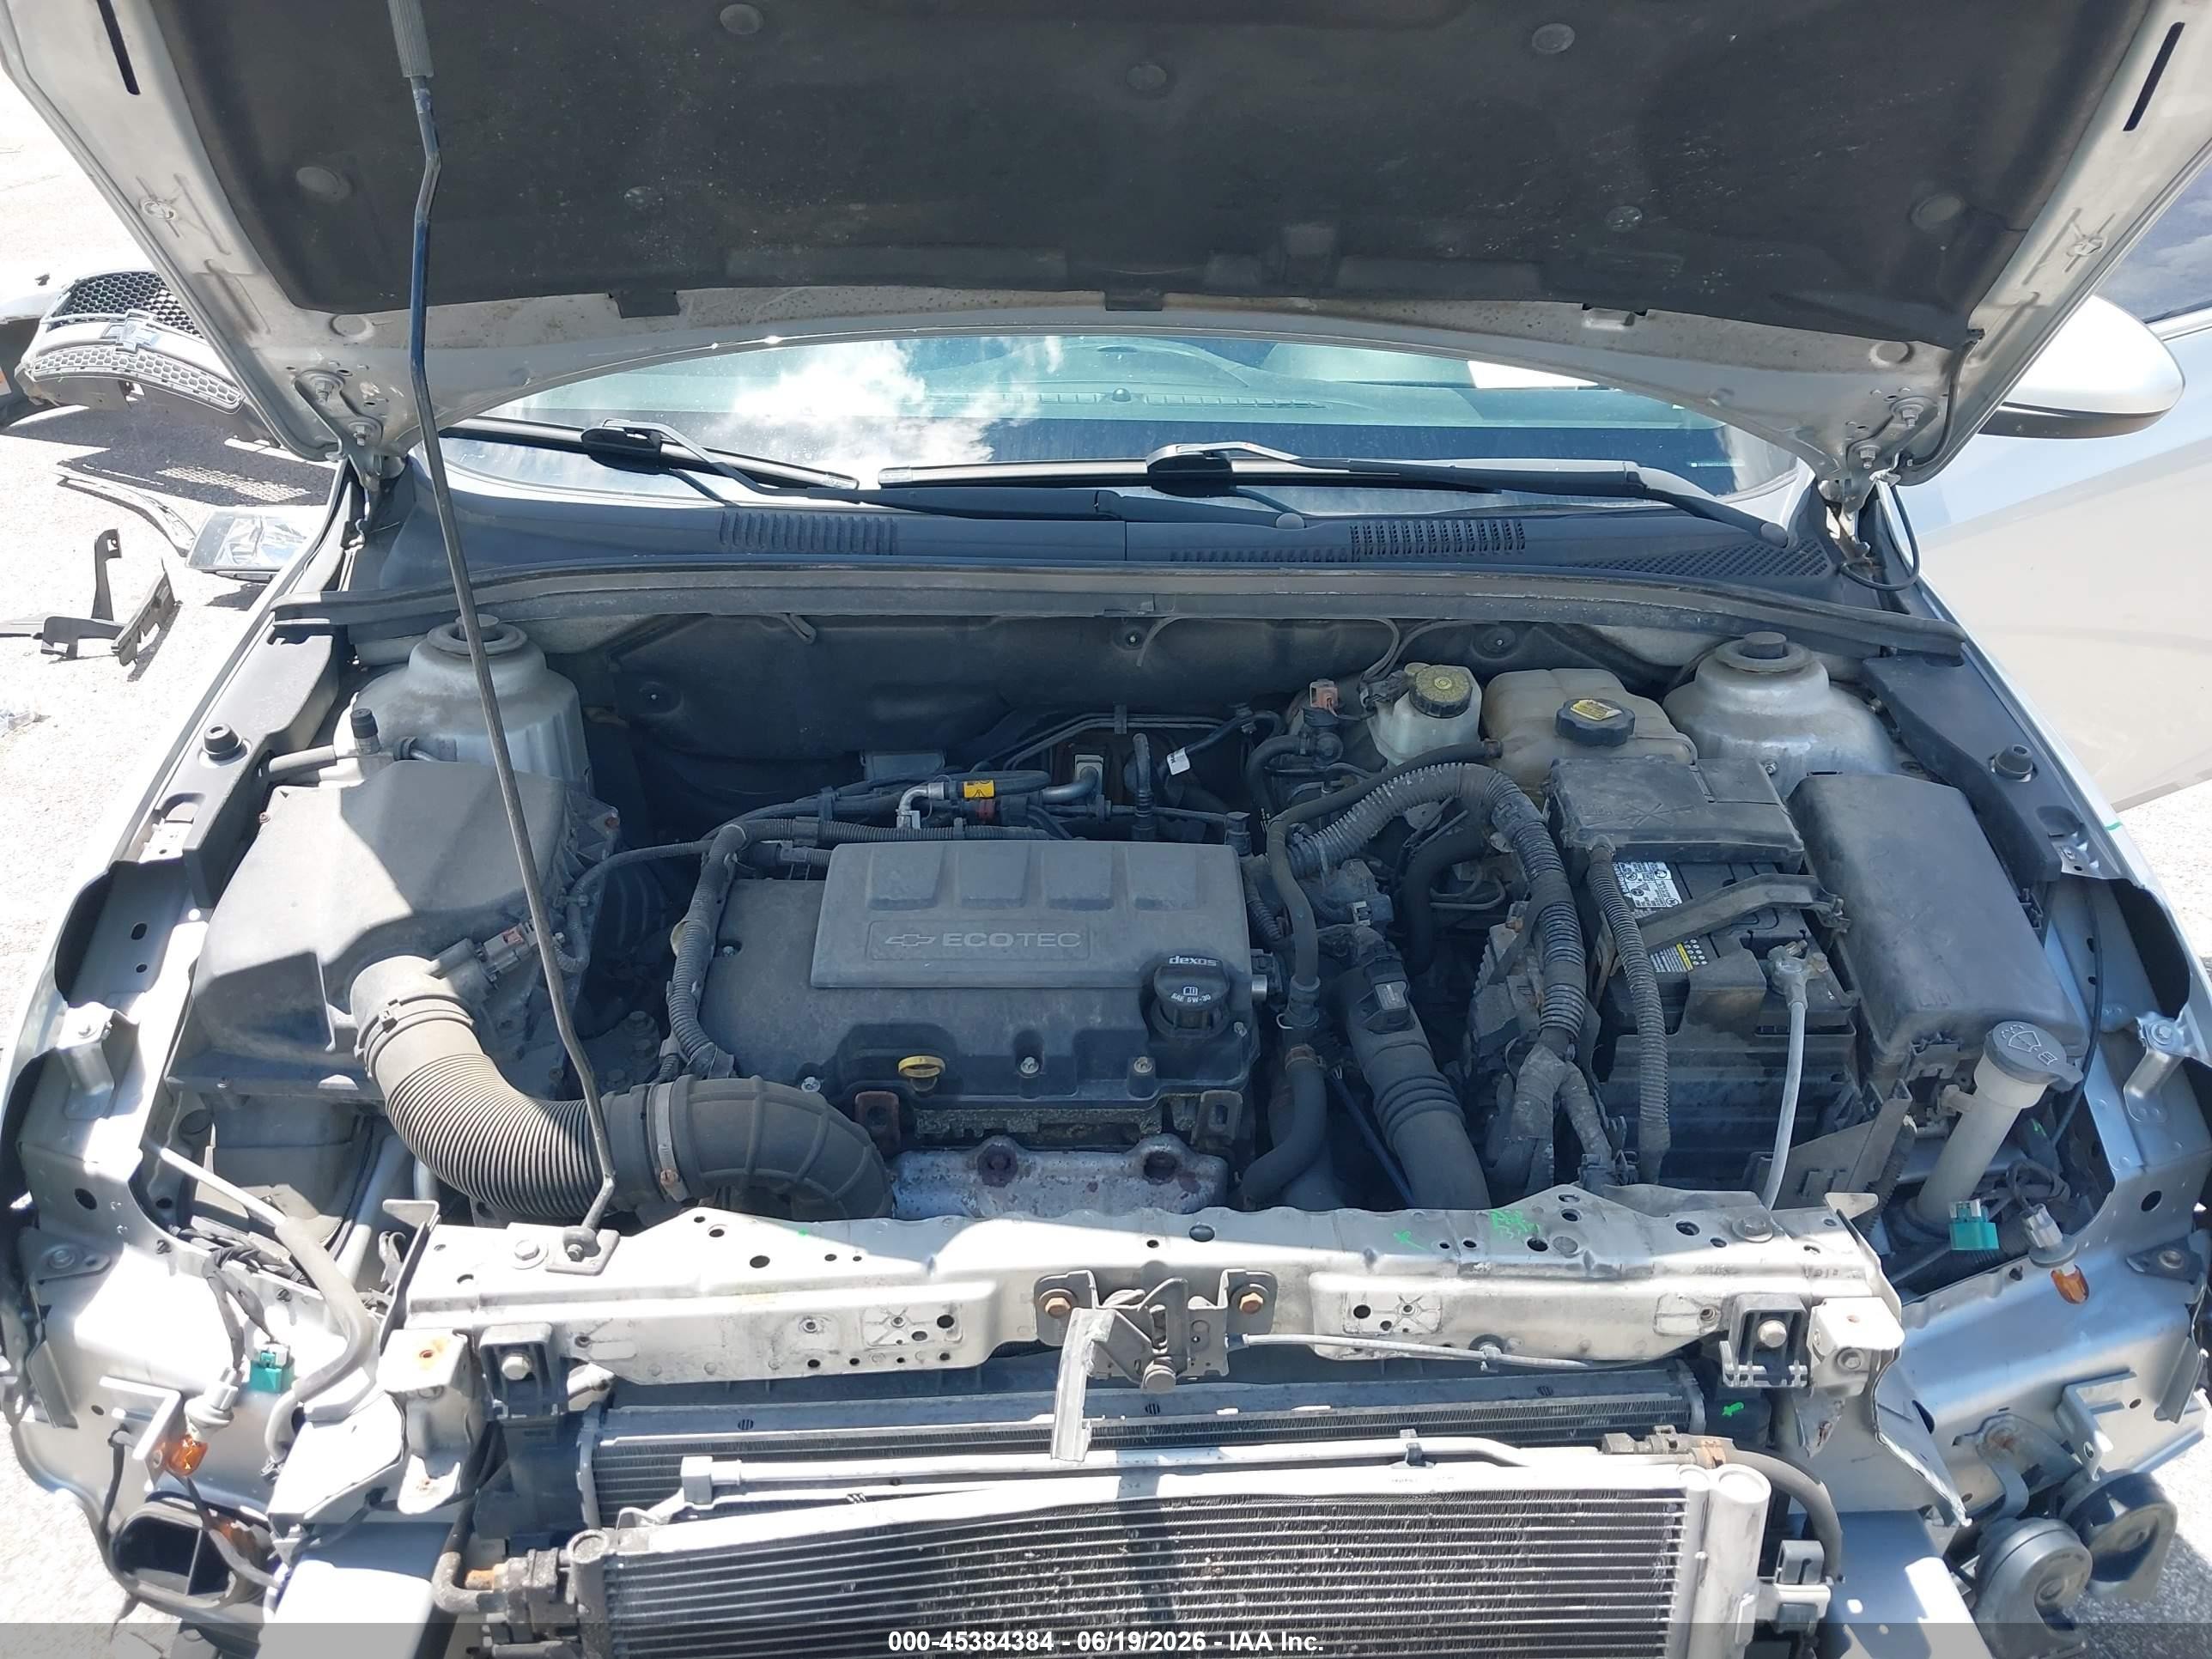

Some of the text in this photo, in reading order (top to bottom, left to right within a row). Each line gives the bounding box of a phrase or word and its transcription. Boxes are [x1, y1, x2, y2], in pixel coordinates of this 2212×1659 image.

[942, 933, 1081, 948] ECOTEC
[1169, 955, 1218, 967] dexos
[1170, 993, 1212, 1004] SAE 5W-30
